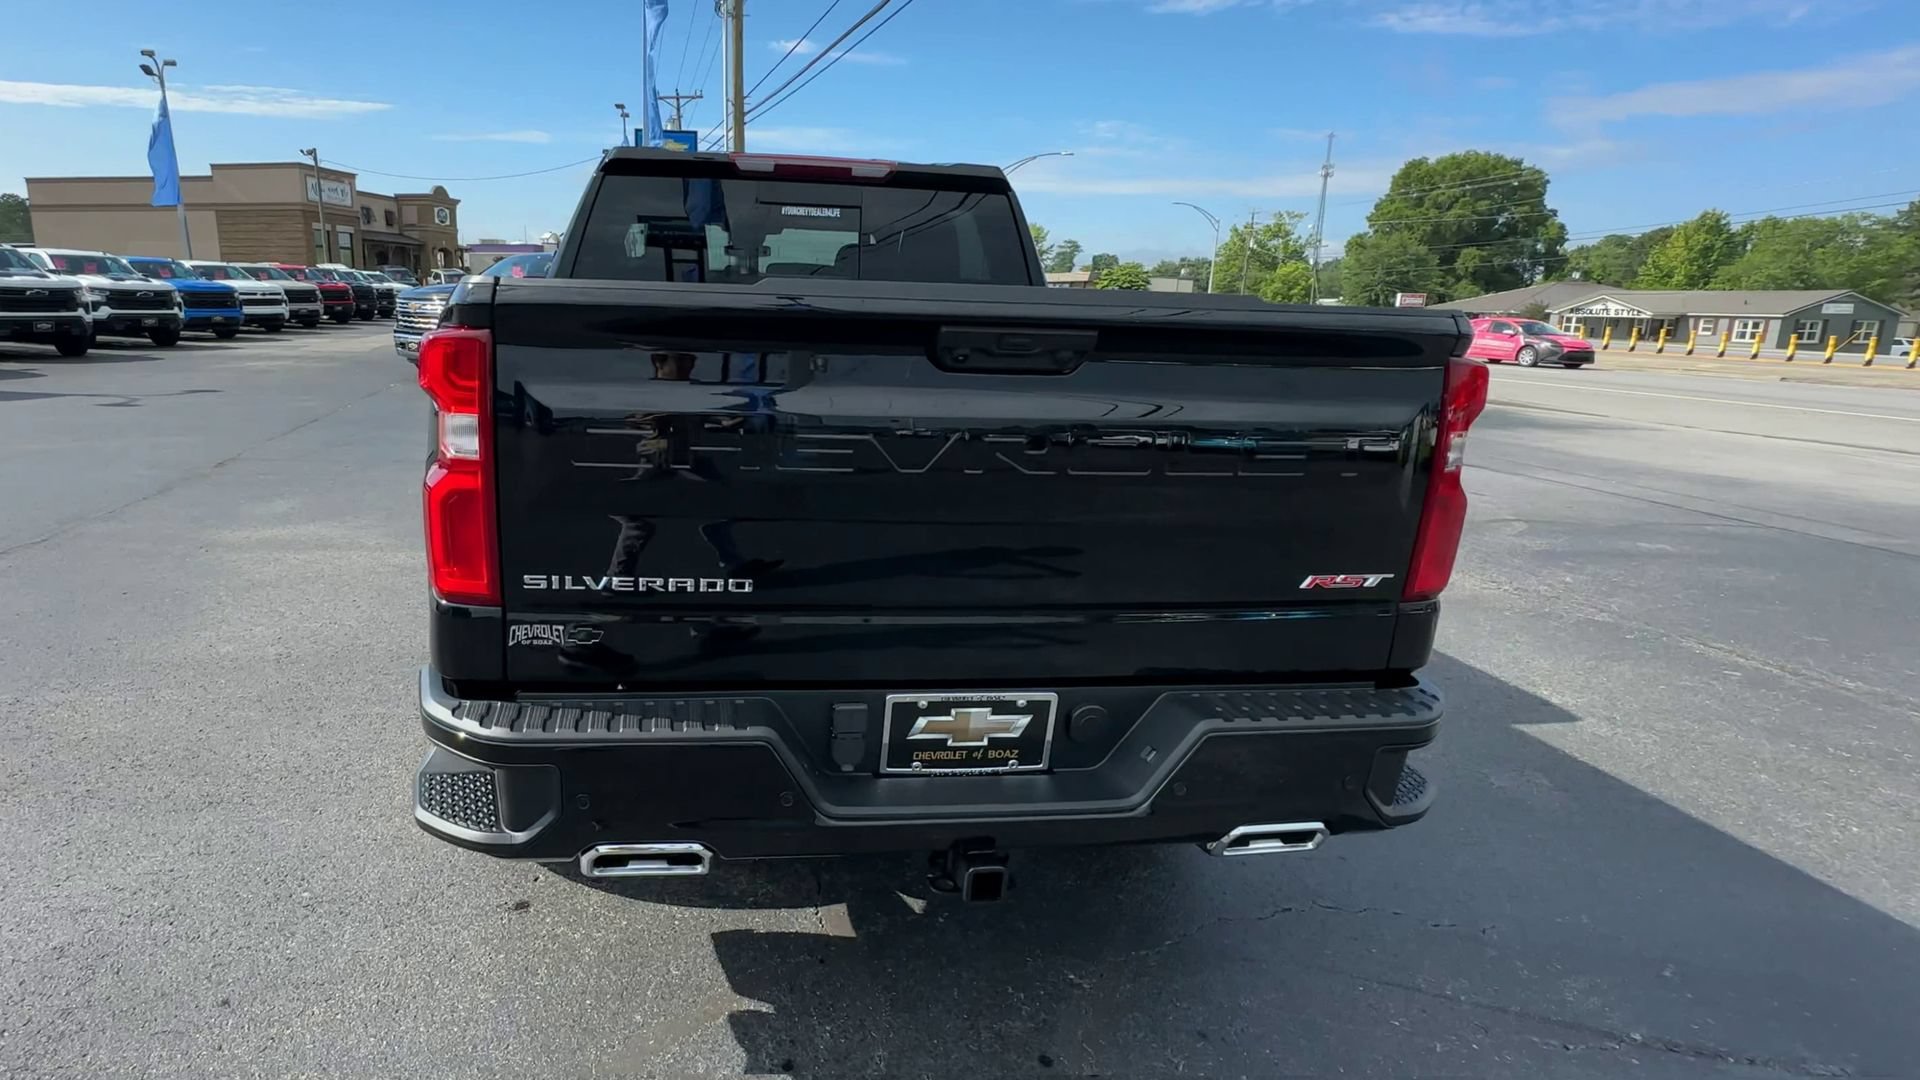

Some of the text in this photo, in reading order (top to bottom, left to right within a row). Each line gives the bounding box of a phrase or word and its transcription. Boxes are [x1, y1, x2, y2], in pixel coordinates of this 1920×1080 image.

[1569, 307, 1642, 316] ABSOLUTE STYLE
[523, 575, 753, 592] SILVERADO
[1299, 574, 1395, 589] RST
[508, 623, 566, 646] CHEVROLET
[913, 749, 1019, 760] CHEVROLET of BOAZ
